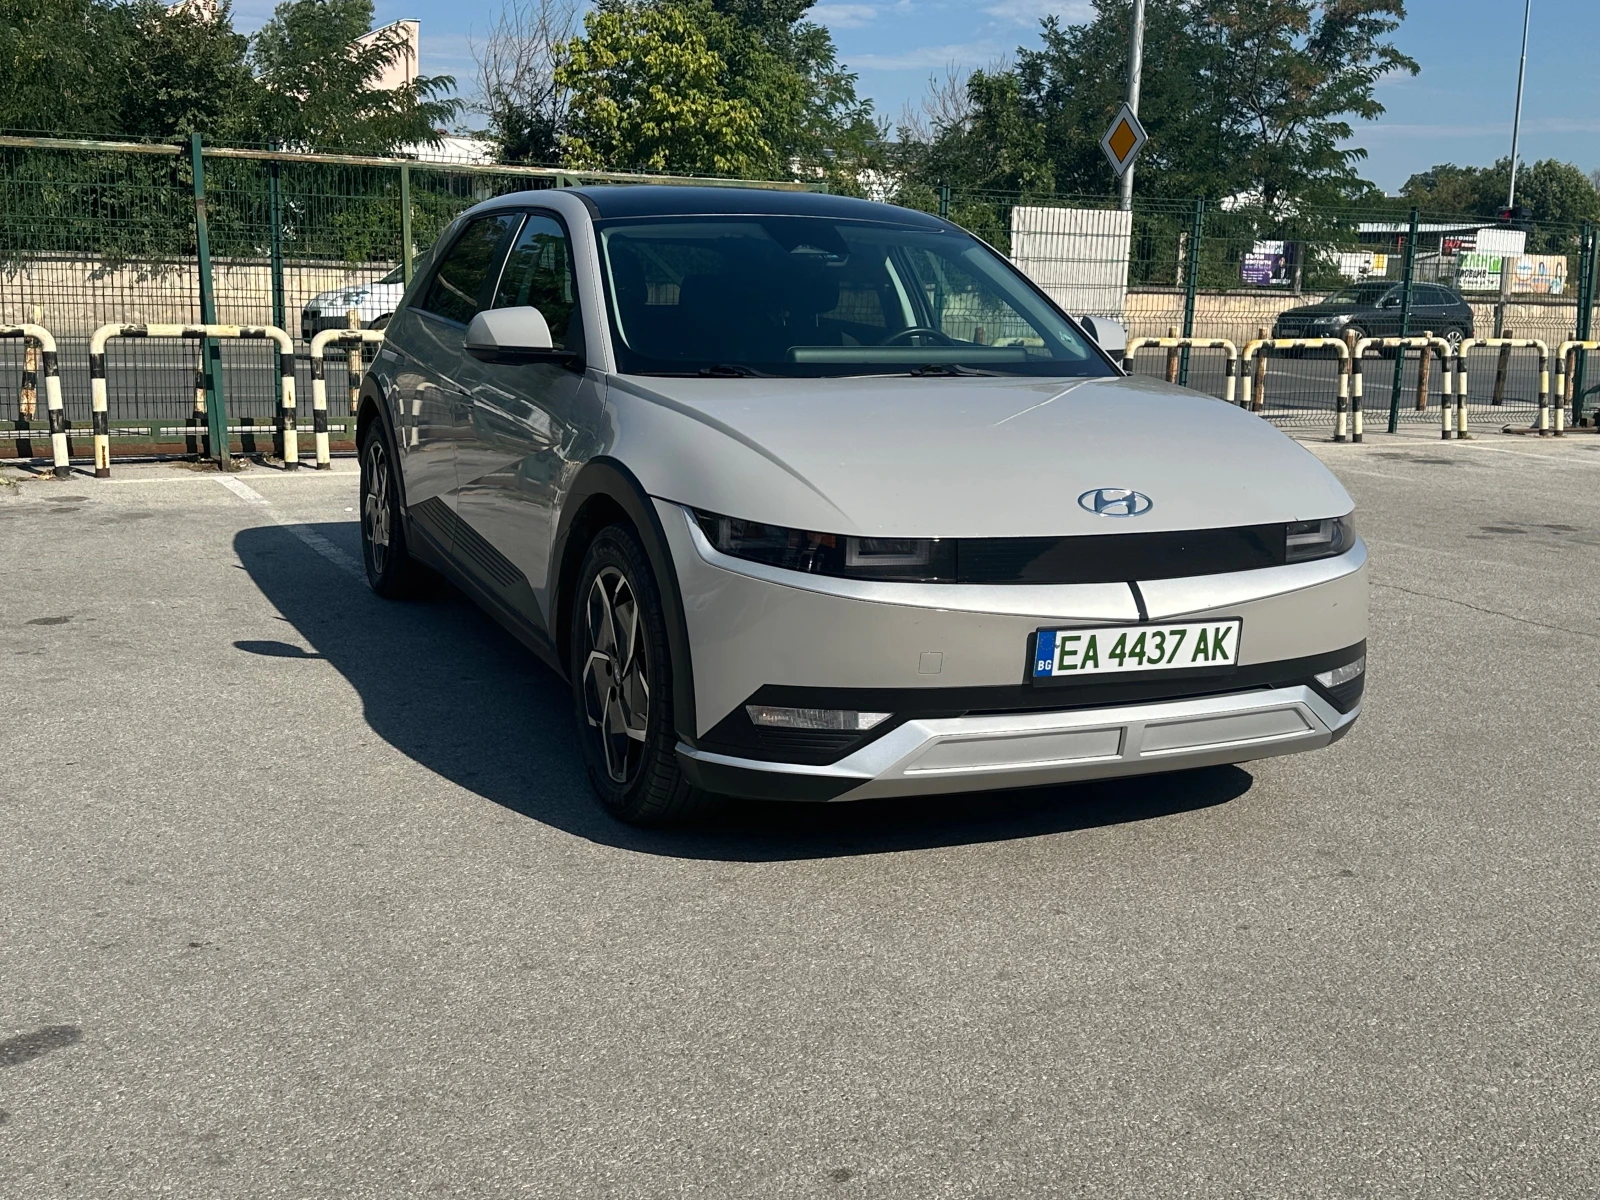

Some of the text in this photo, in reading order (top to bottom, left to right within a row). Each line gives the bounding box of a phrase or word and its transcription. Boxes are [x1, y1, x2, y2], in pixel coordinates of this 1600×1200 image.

[1058, 626, 1232, 670] EA 4437 AK
[1037, 660, 1052, 670] BG
